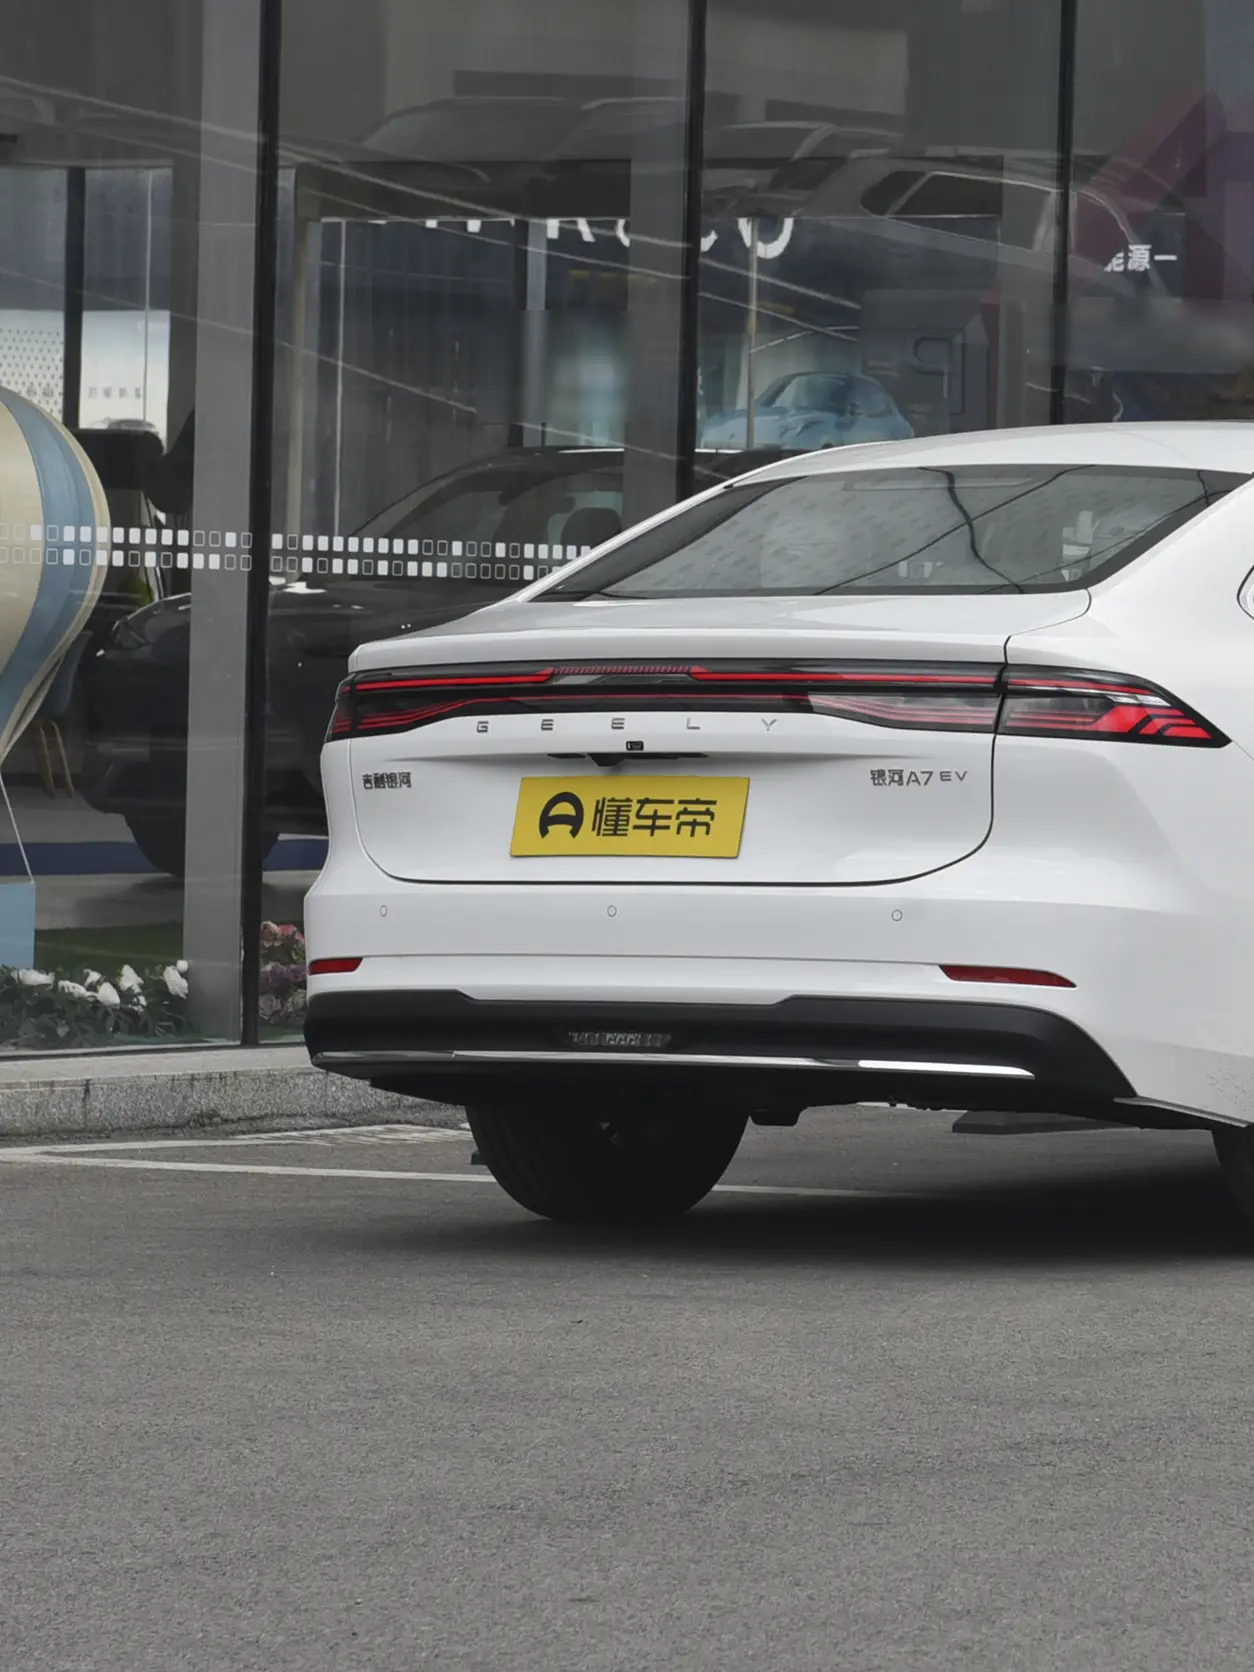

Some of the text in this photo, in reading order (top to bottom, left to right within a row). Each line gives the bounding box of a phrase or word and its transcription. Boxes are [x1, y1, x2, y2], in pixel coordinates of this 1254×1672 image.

[475, 717, 778, 734] GEELY
[869, 768, 969, 787] 银河A7 EV
[590, 796, 718, 839] 懂车帝
